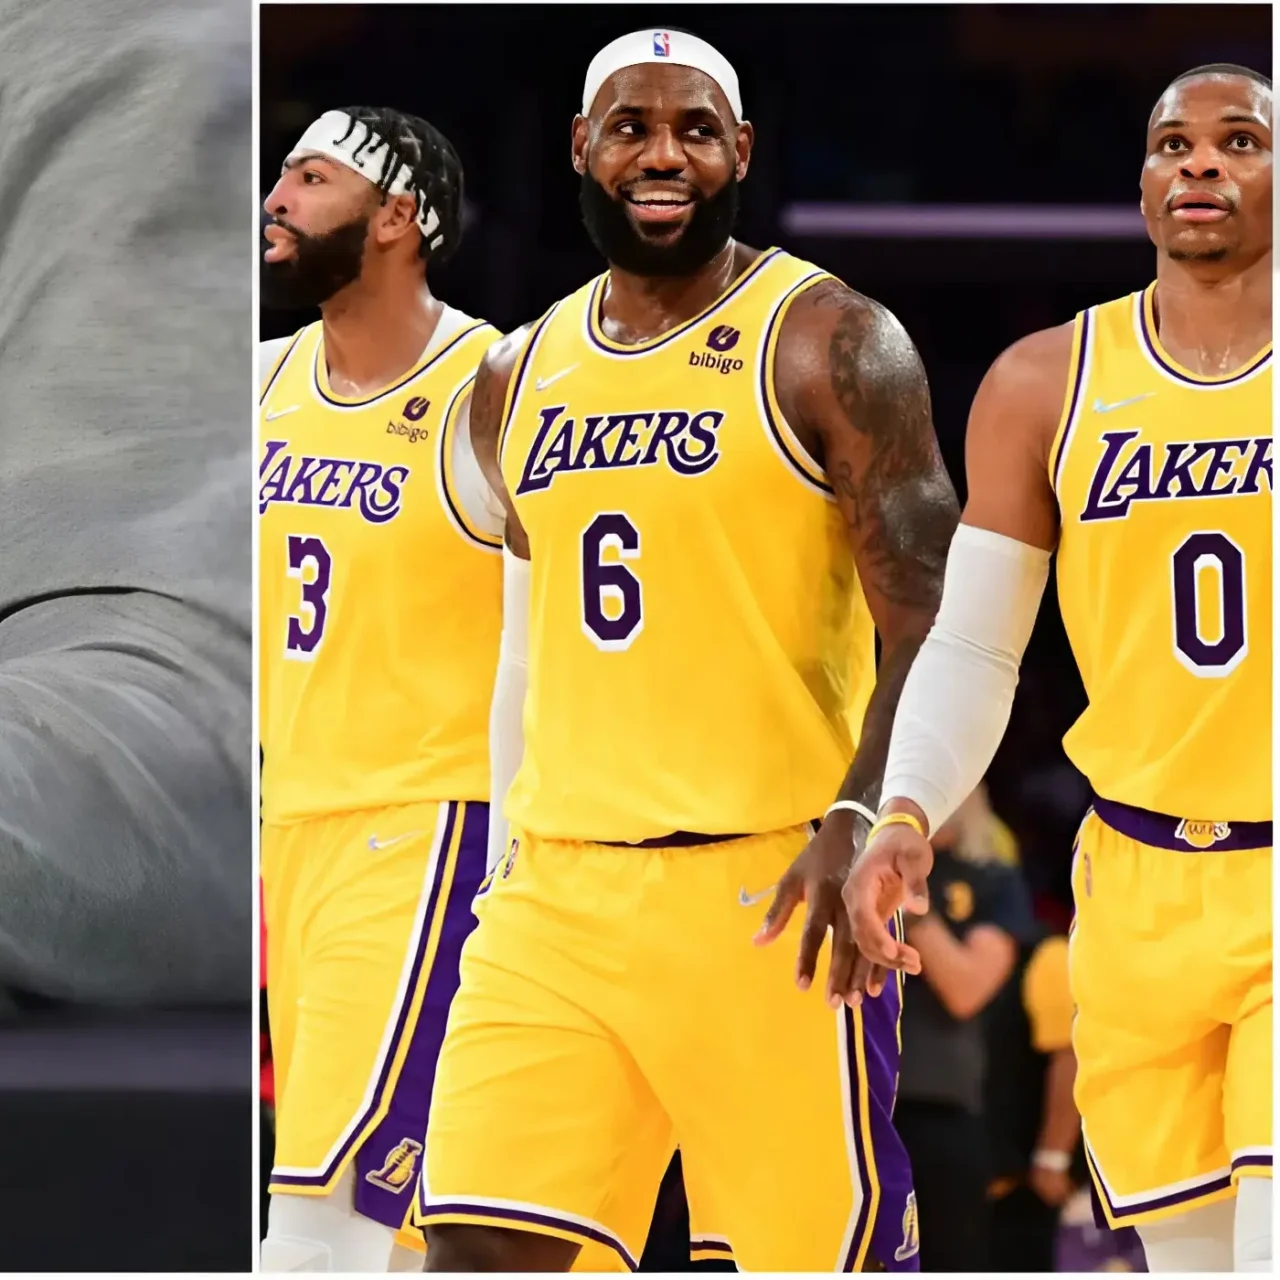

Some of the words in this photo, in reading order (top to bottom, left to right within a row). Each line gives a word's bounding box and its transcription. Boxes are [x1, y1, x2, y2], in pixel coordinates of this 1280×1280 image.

[688, 351, 744, 375] bibigo
[516, 405, 724, 495] LAKERS
[285, 534, 333, 658] 3
[581, 512, 643, 647] 6
[1172, 531, 1247, 673] 0
